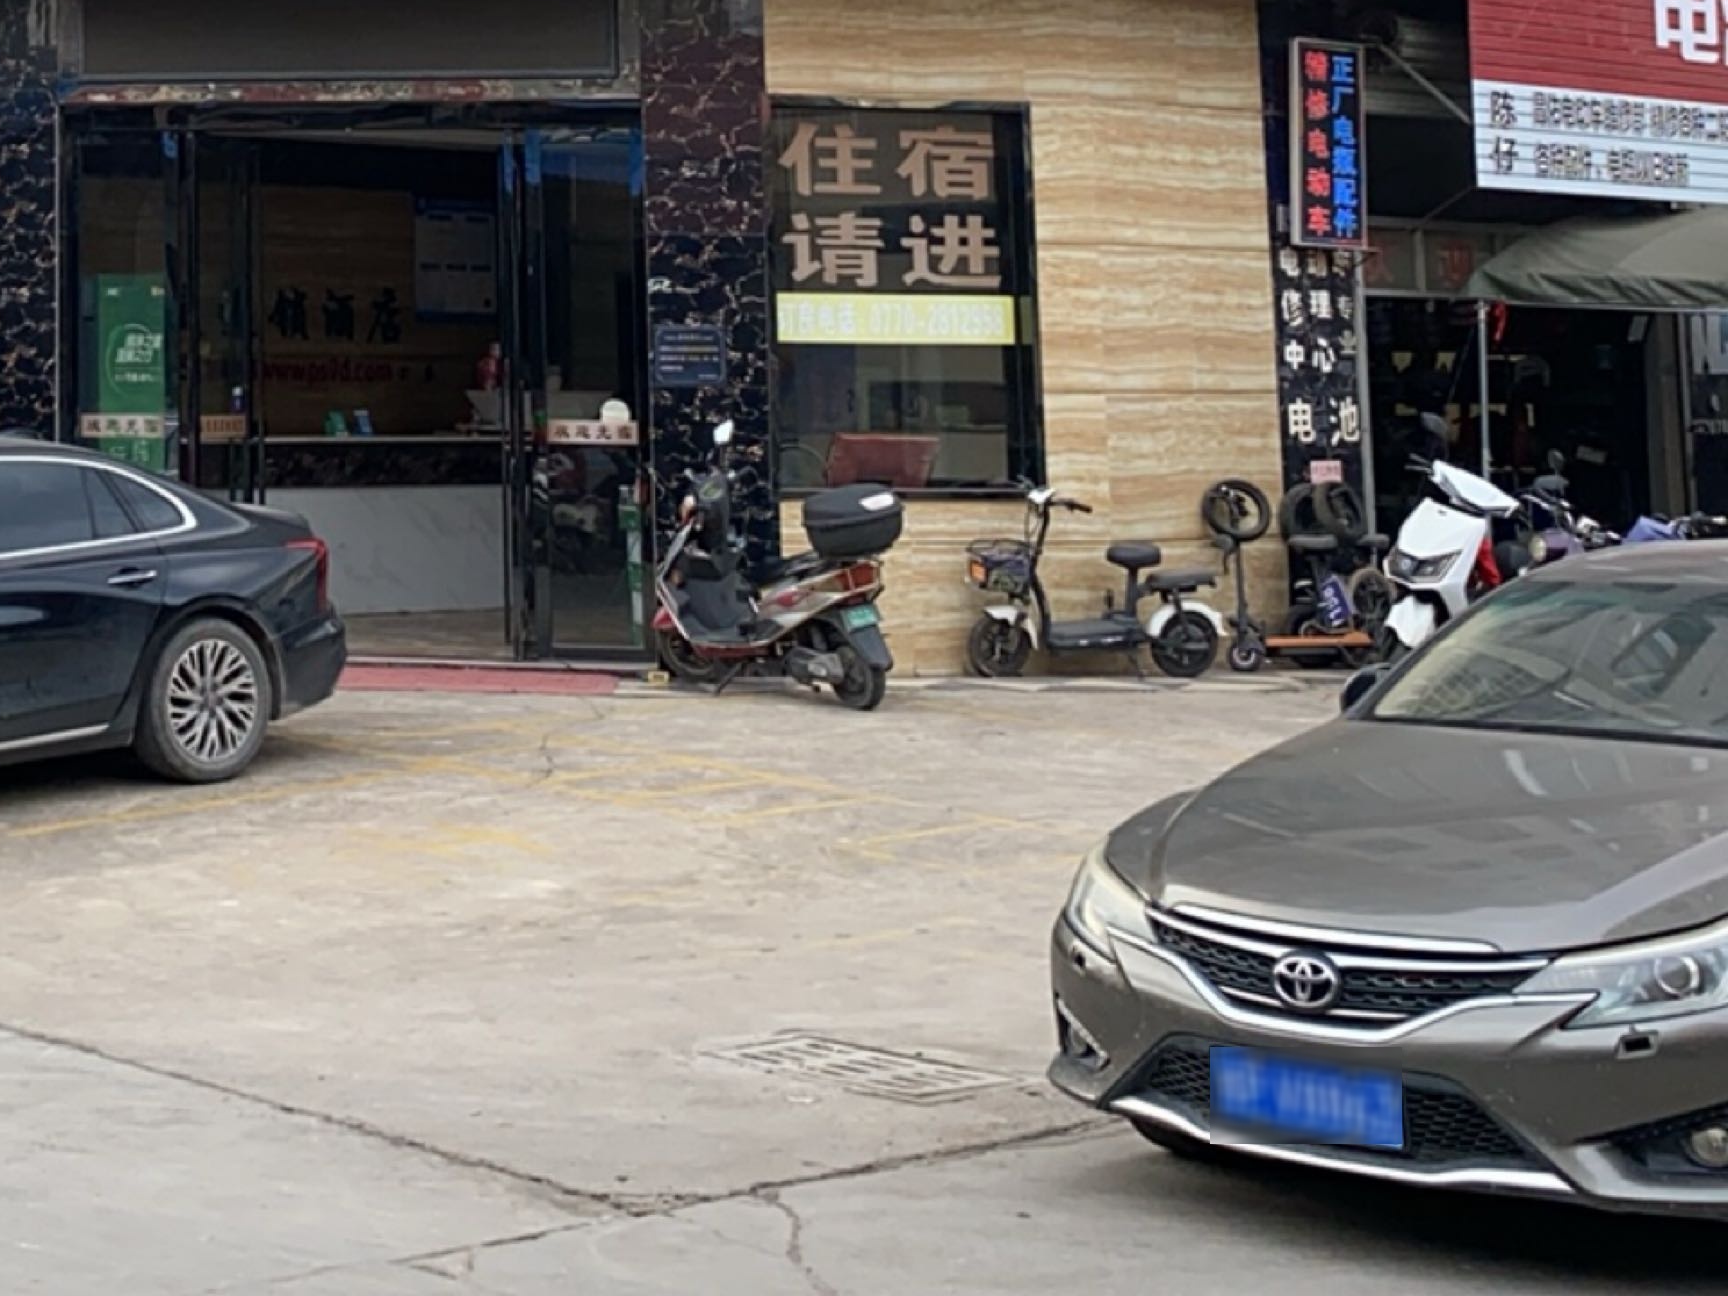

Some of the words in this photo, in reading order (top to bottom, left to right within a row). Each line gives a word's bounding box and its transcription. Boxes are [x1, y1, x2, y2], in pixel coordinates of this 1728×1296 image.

[780, 121, 997, 202] 住宿
[780, 211, 1002, 289] 请进
[1287, 396, 1360, 446] 电池
